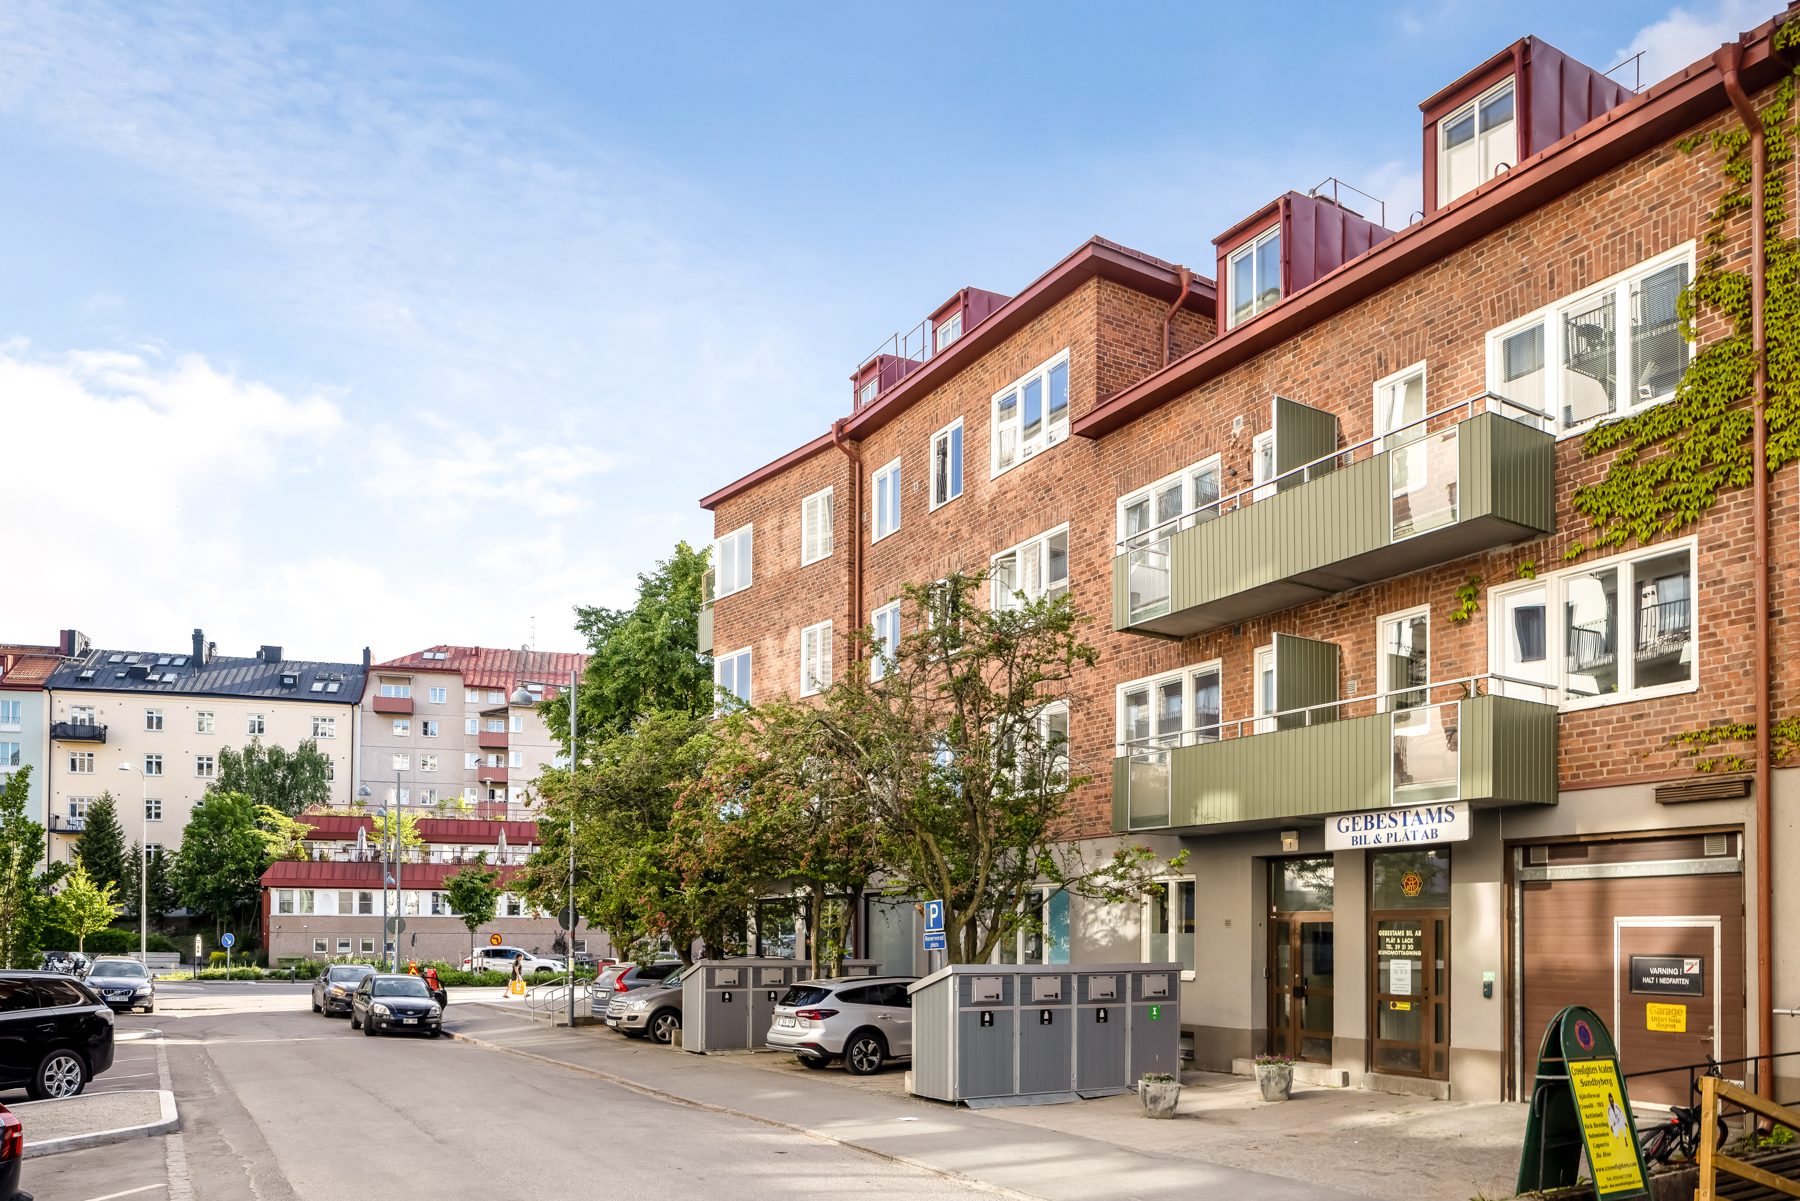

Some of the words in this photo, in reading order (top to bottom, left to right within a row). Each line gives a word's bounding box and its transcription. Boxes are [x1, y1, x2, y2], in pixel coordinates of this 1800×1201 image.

[1337, 805, 1455, 833] GEBESTAMS
[1351, 834, 1371, 846] BIL
[1373, 833, 1382, 844] &
[1386, 828, 1418, 843] PLÅT
[1421, 828, 1438, 840] AB
[930, 904, 938, 928] P
[1650, 967, 1678, 975] VARNING
[1649, 1005, 1683, 1017] Garage
[1580, 1077, 1613, 1088] Sundbyberg
